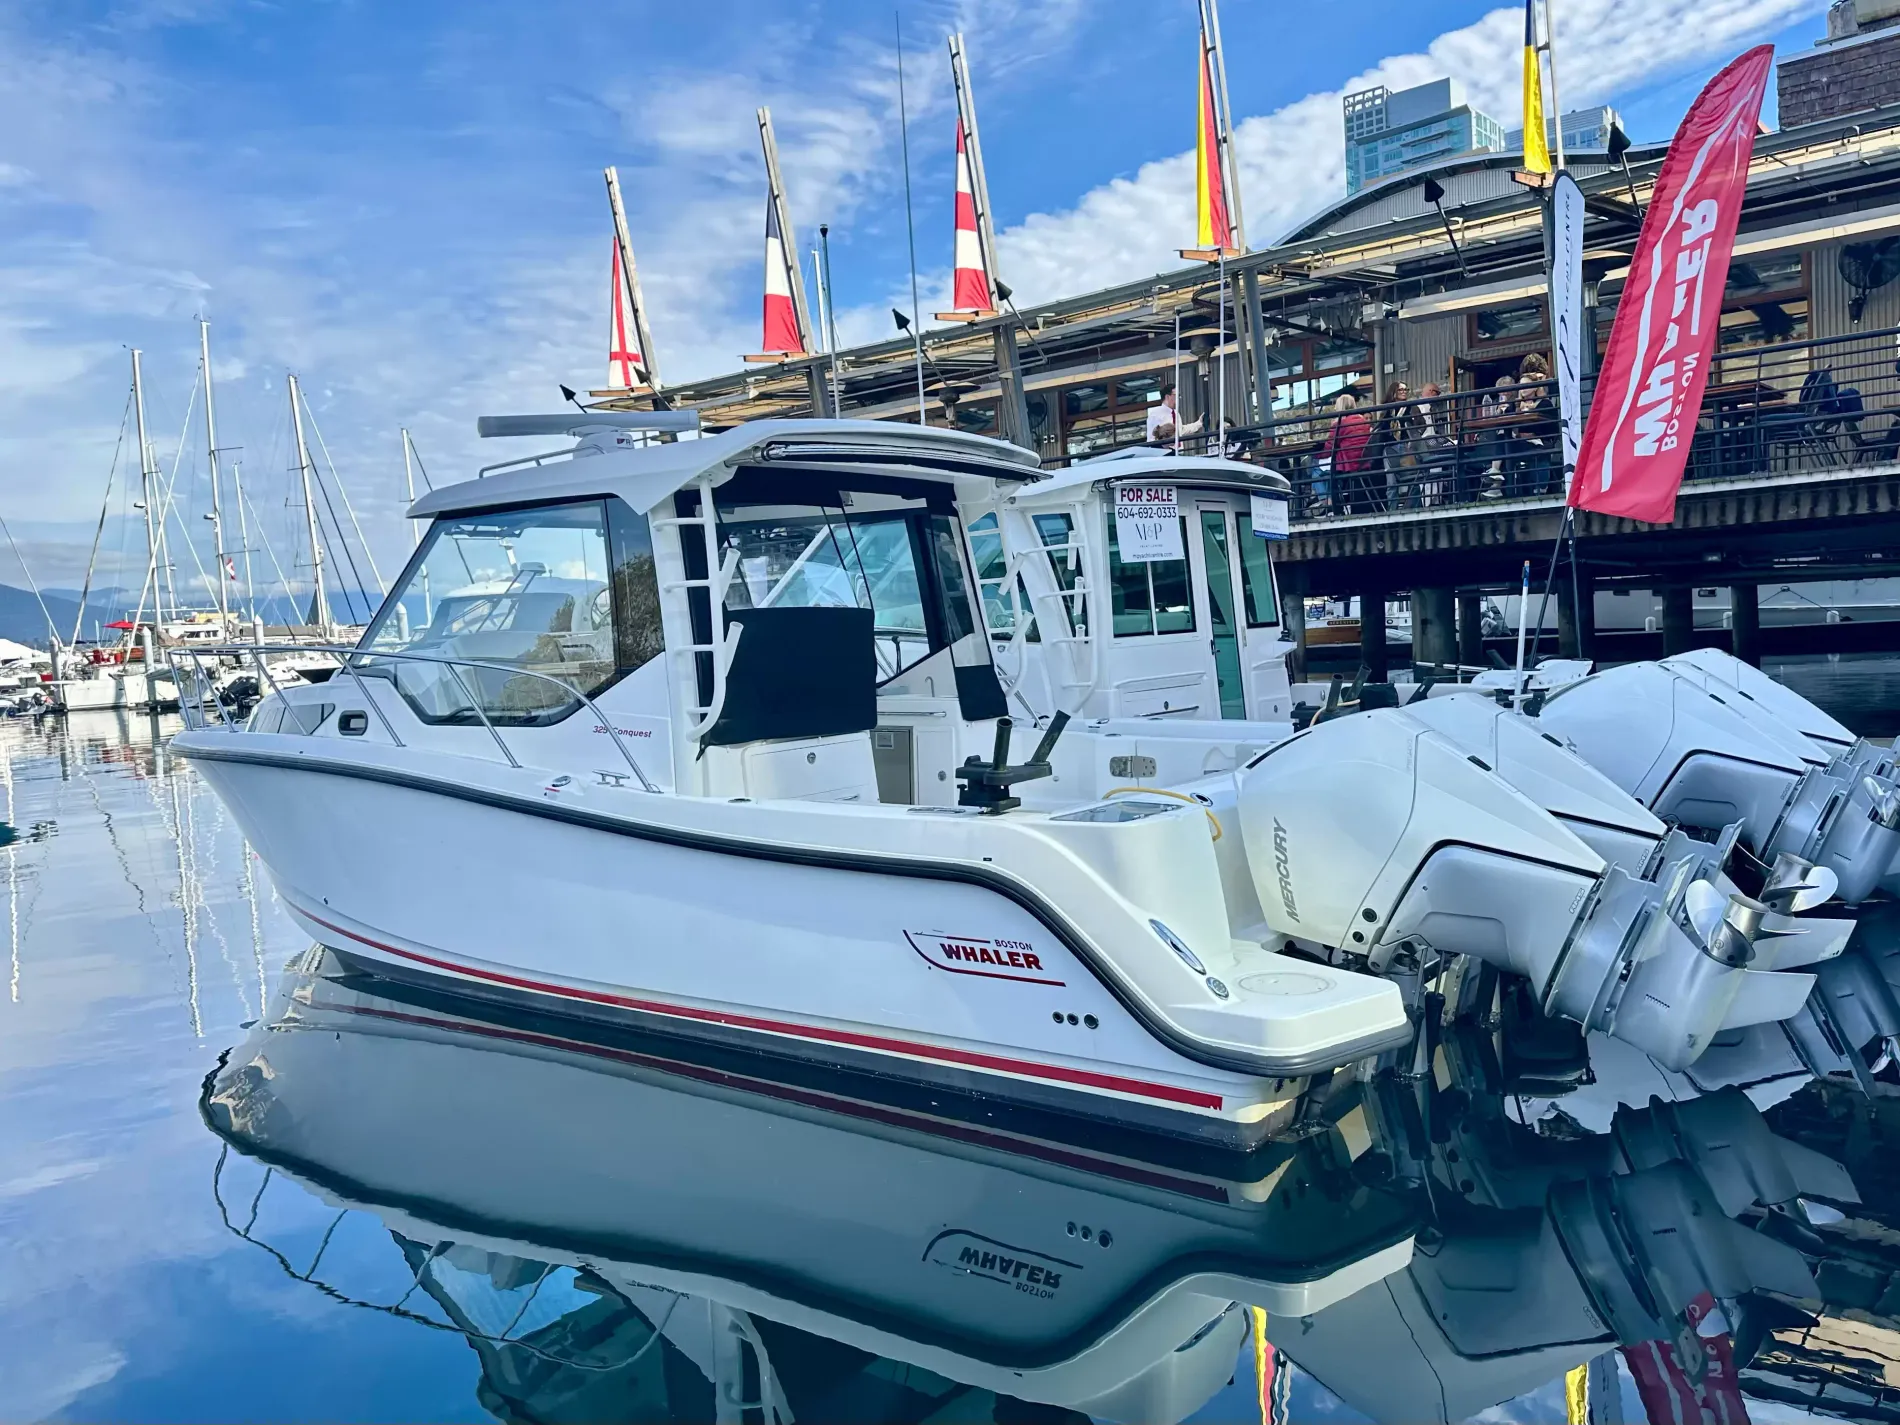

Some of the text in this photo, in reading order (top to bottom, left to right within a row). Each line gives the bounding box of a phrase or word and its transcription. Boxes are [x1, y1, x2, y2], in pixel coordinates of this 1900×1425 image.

[1120, 487, 1173, 503] FOR SALE
[1117, 506, 1177, 519] 604-692-0333
[592, 725, 652, 738] 325 Conquest
[1273, 815, 1301, 924] MERCURY
[994, 939, 1033, 951] BOSTON
[939, 943, 1044, 970] WHALER
